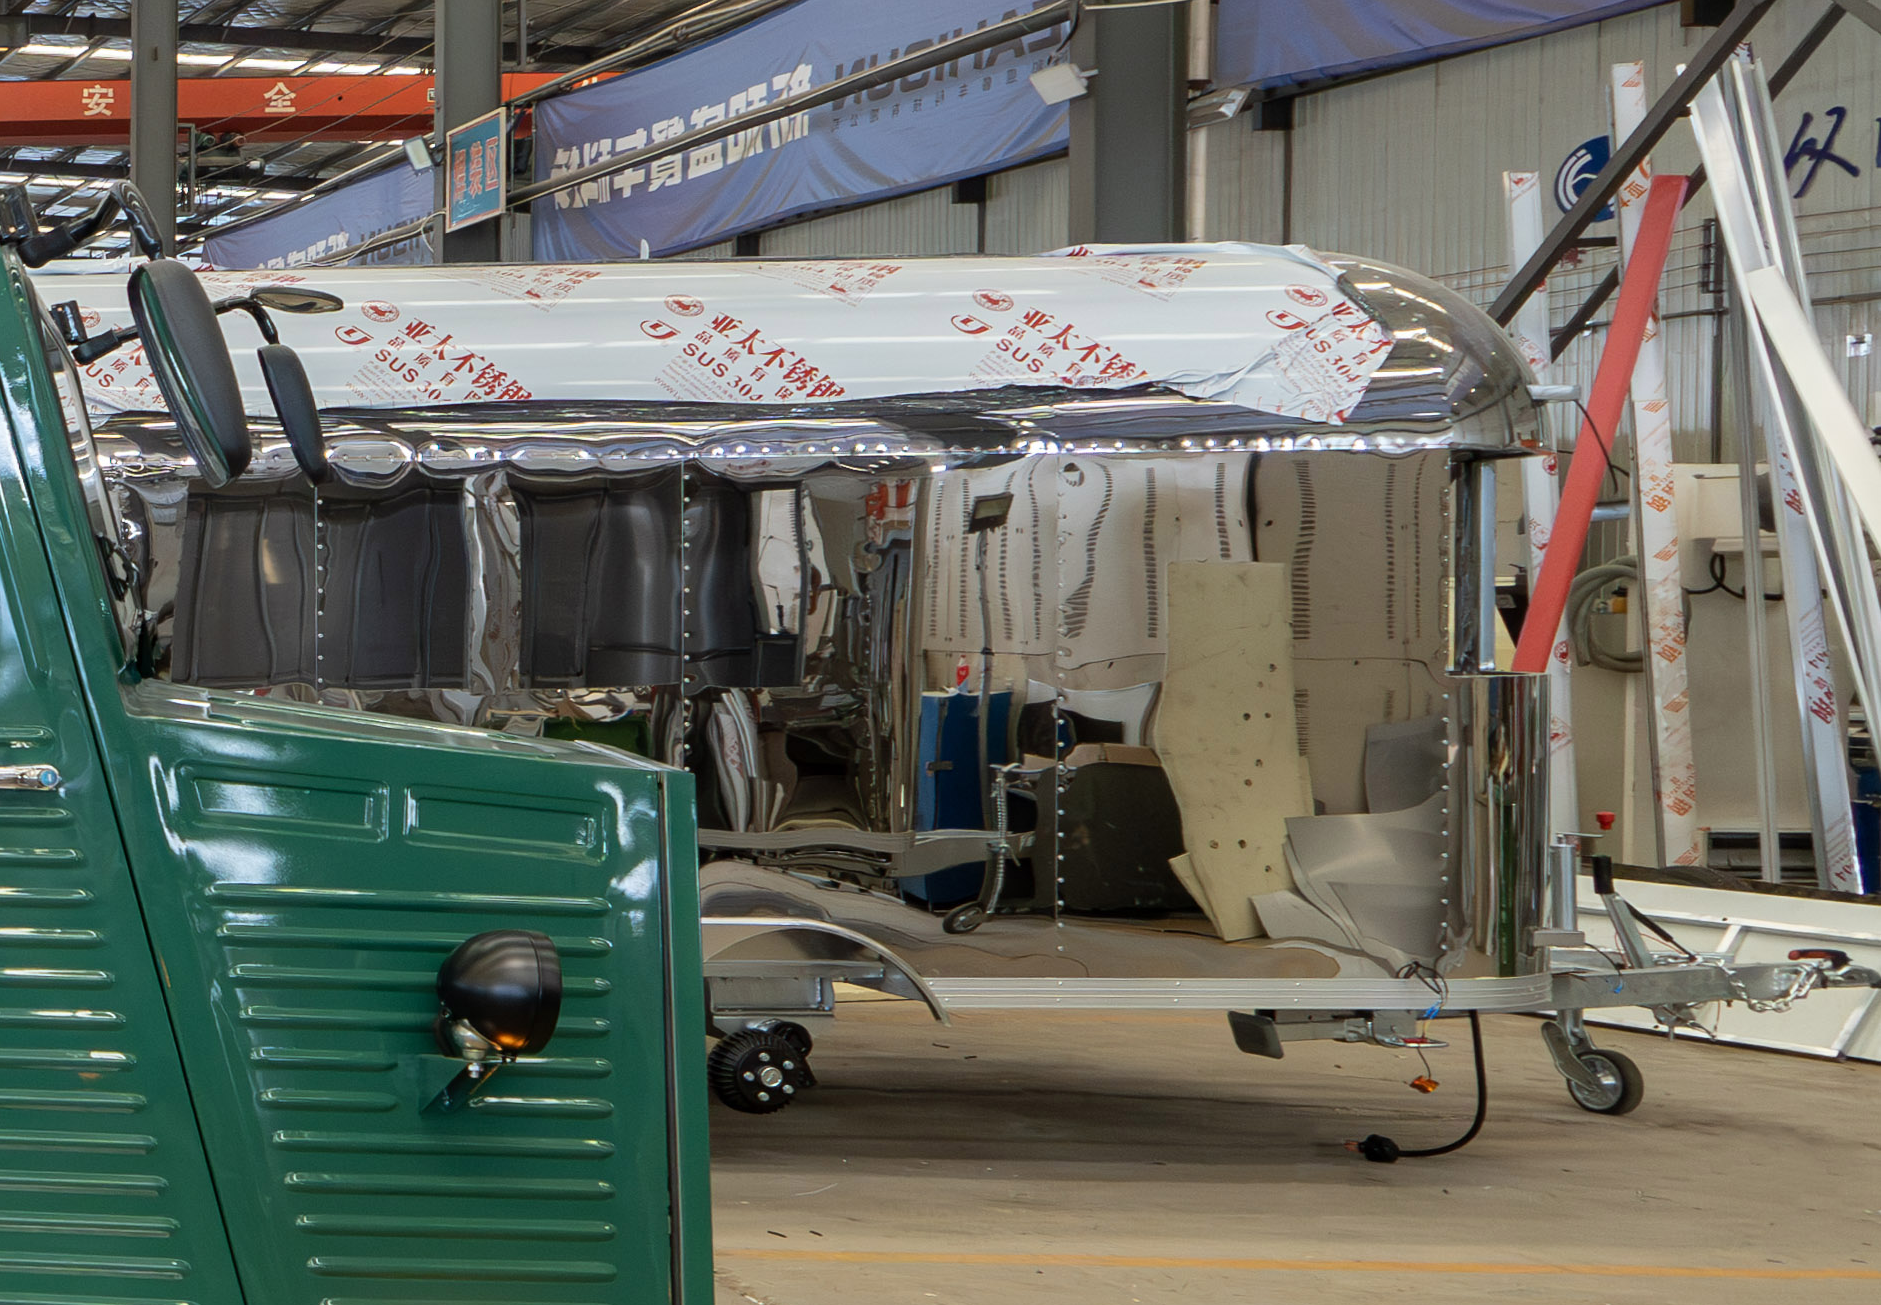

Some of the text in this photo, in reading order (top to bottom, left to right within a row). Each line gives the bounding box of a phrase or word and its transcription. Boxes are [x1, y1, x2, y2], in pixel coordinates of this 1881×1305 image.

[374, 348, 420, 383] SUS
[682, 343, 729, 379] SUS
[996, 338, 1044, 373] SUS
